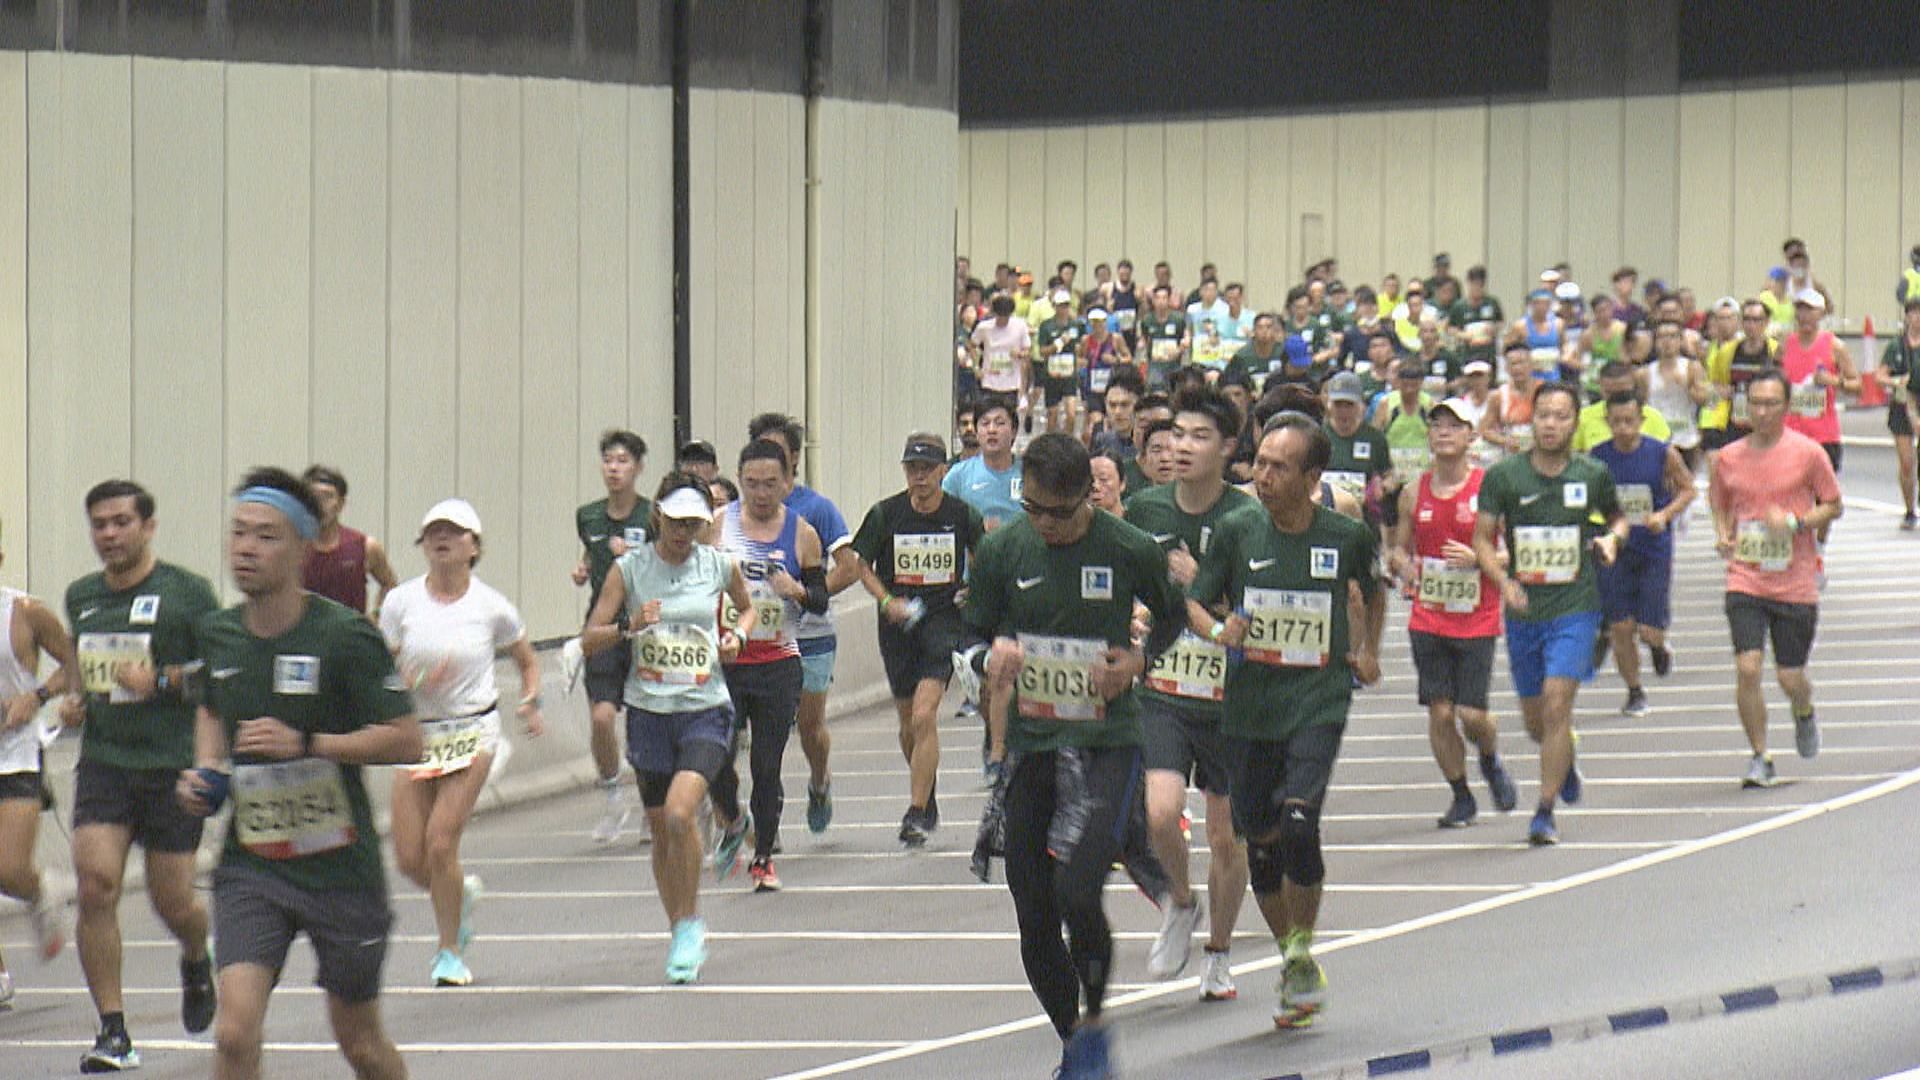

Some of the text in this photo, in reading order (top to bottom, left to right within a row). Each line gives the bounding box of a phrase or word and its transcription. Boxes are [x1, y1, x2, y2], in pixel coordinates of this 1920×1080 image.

[897, 552, 953, 570] G1499
[726, 606, 782, 626] G87
[1249, 617, 1324, 644] G1771
[641, 643, 708, 667] G2566
